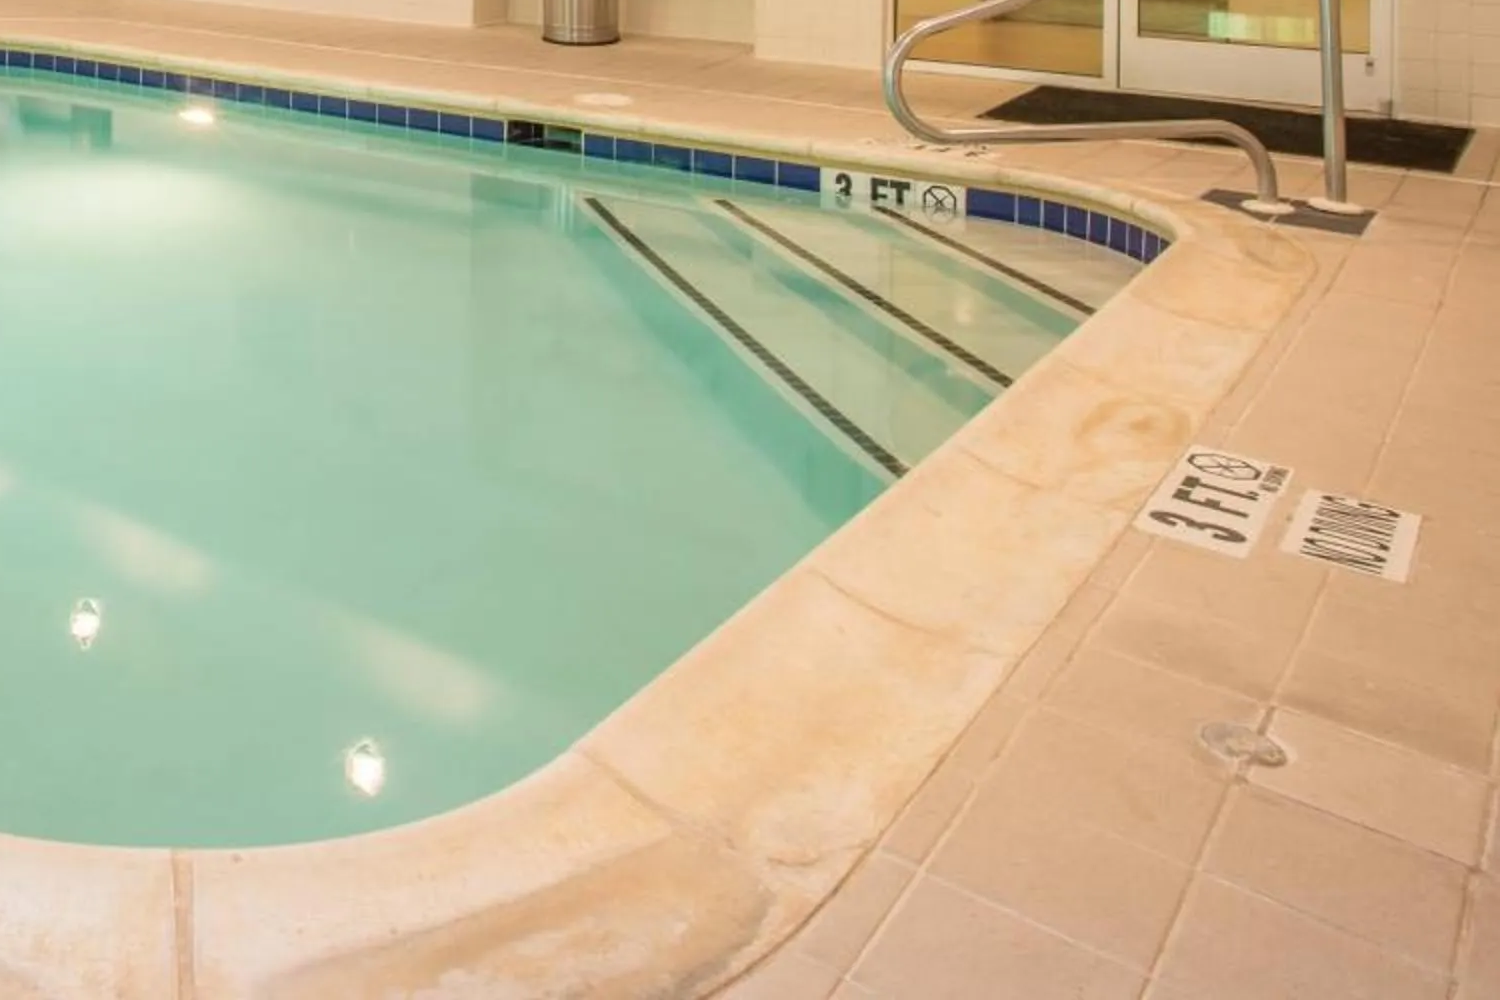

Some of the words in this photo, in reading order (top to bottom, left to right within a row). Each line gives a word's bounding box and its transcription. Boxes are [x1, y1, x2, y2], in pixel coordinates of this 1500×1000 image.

[835, 172, 852, 197] 3
[871, 177, 910, 205] FT
[1149, 510, 1247, 543] 3
[1300, 537, 1386, 575] NO
